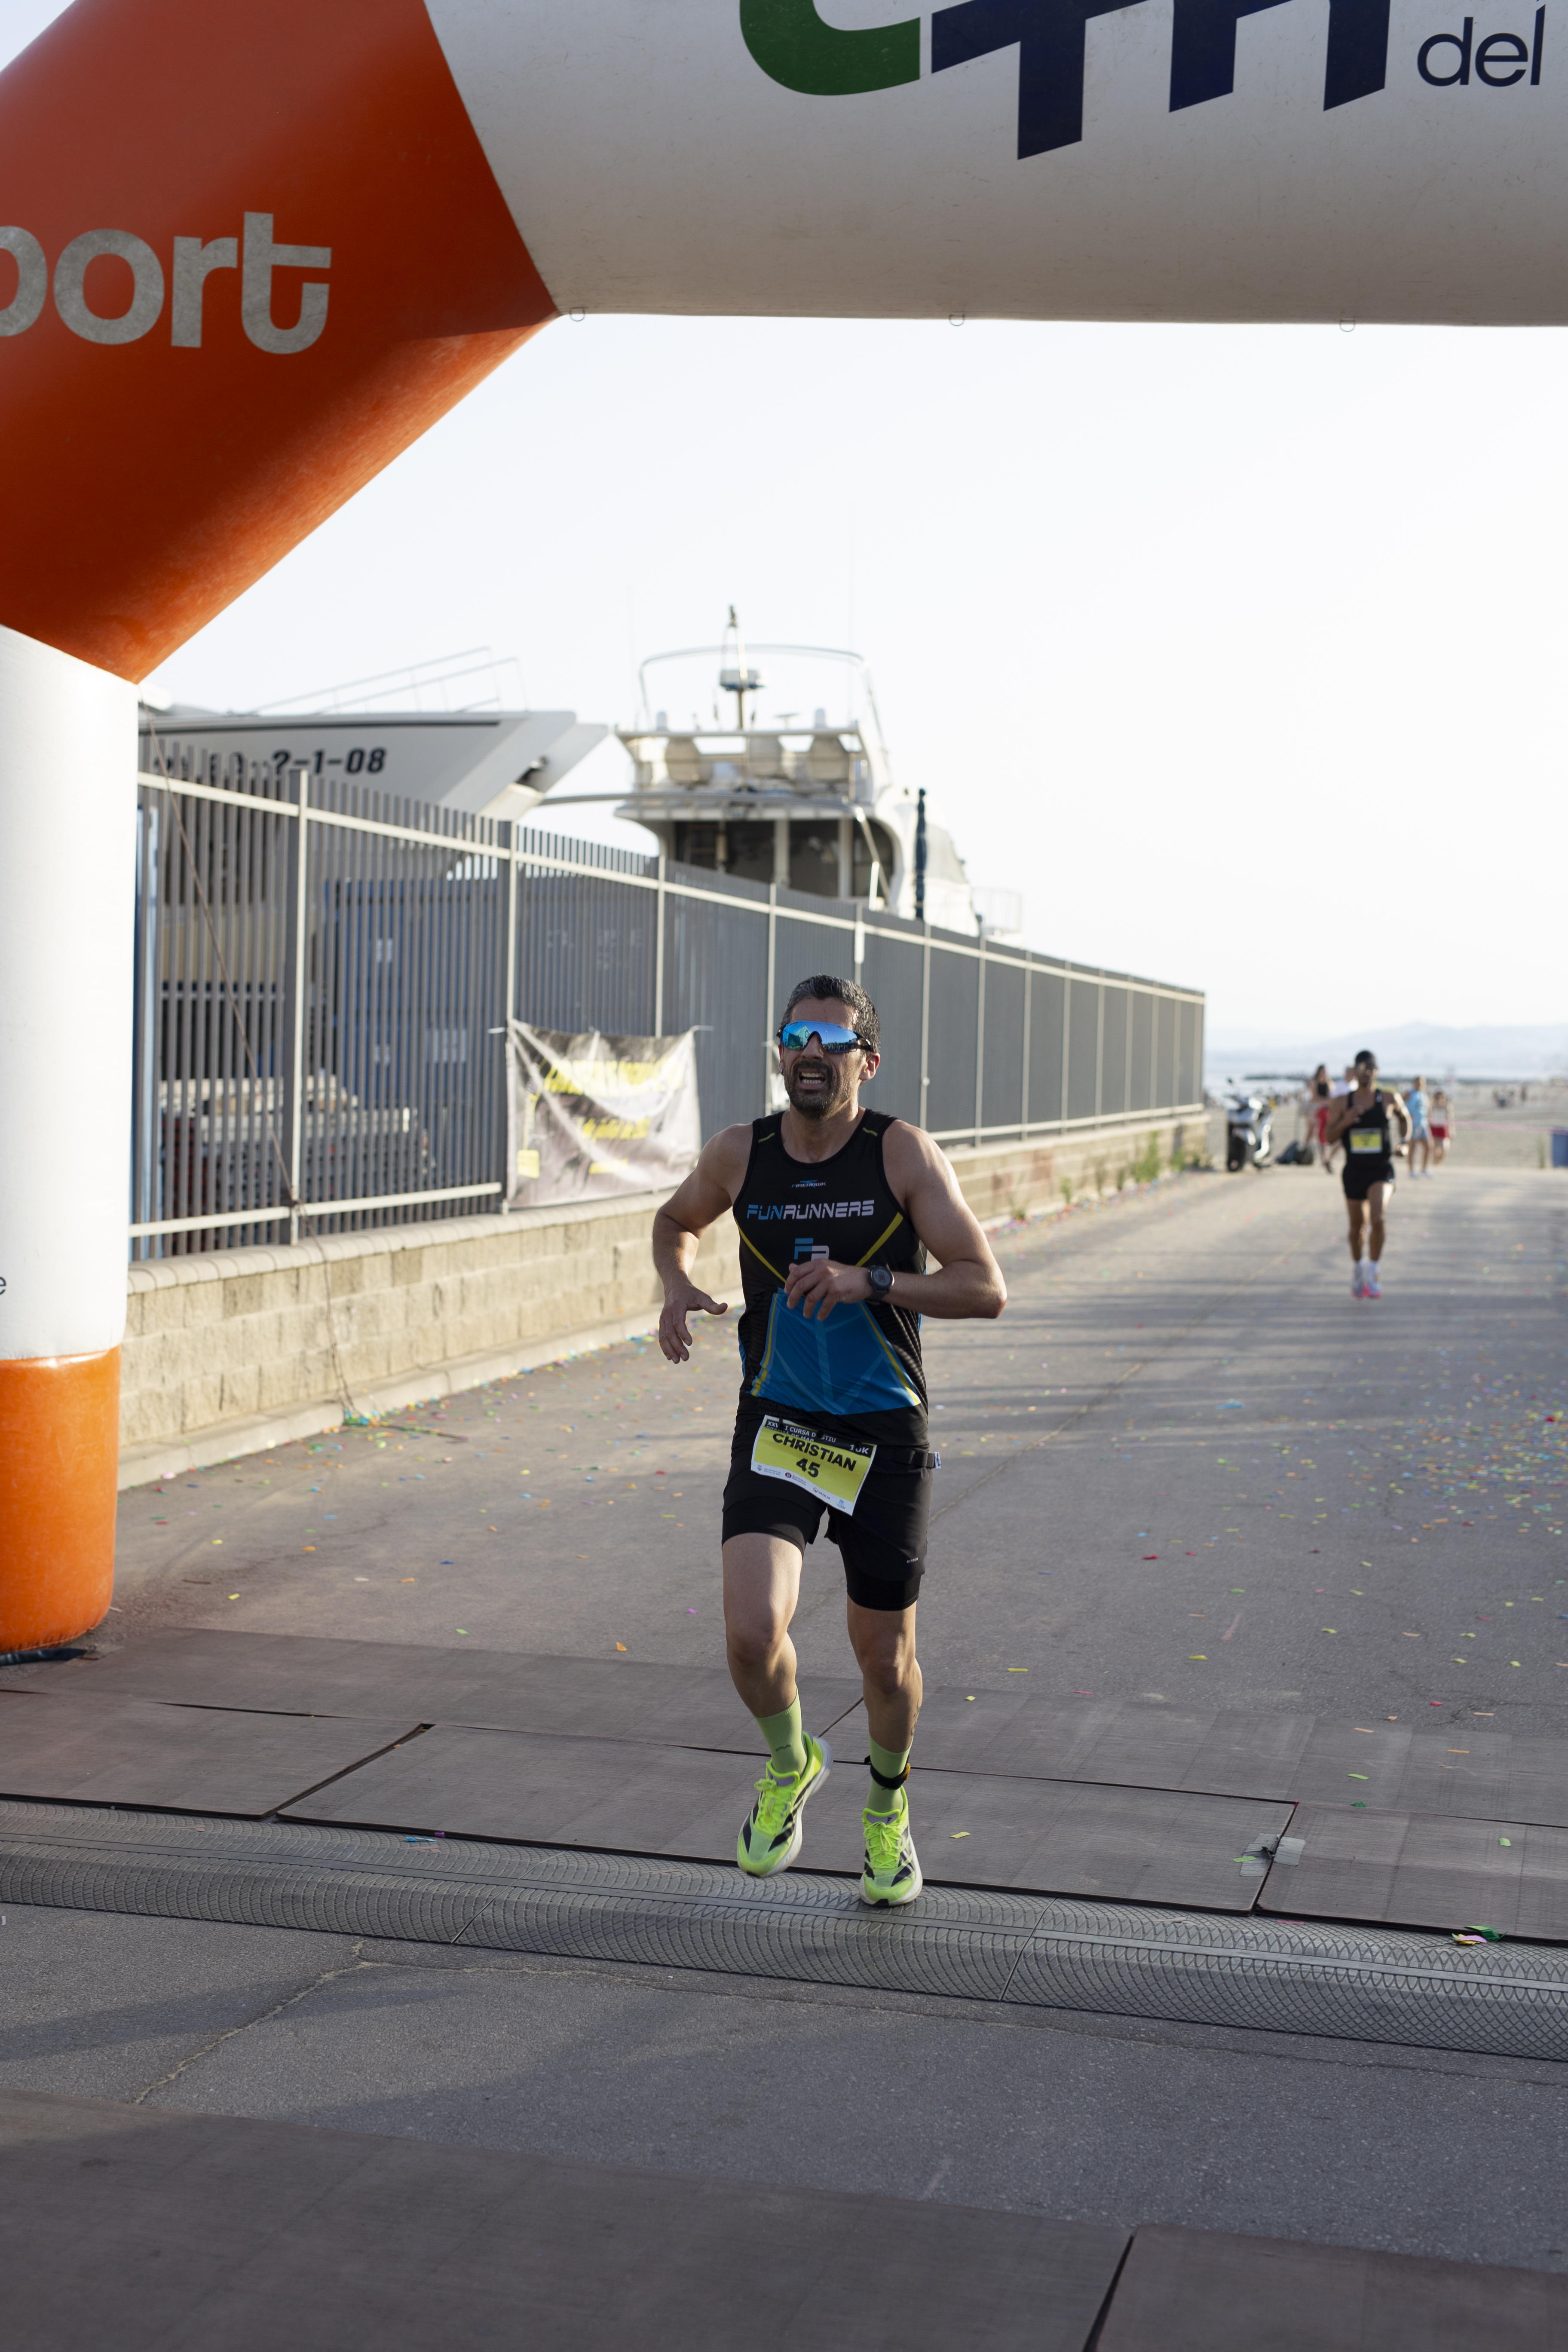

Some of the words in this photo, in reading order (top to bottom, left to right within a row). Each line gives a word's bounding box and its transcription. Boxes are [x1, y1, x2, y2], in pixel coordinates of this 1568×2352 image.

[1416, 4, 1546, 87] del
[747, 1199, 875, 1220] FUNRUNNERS
[790, 1426, 810, 1436] CURSA
[772, 1433, 857, 1472] CHRISTIAN
[796, 1458, 821, 1478] 45
